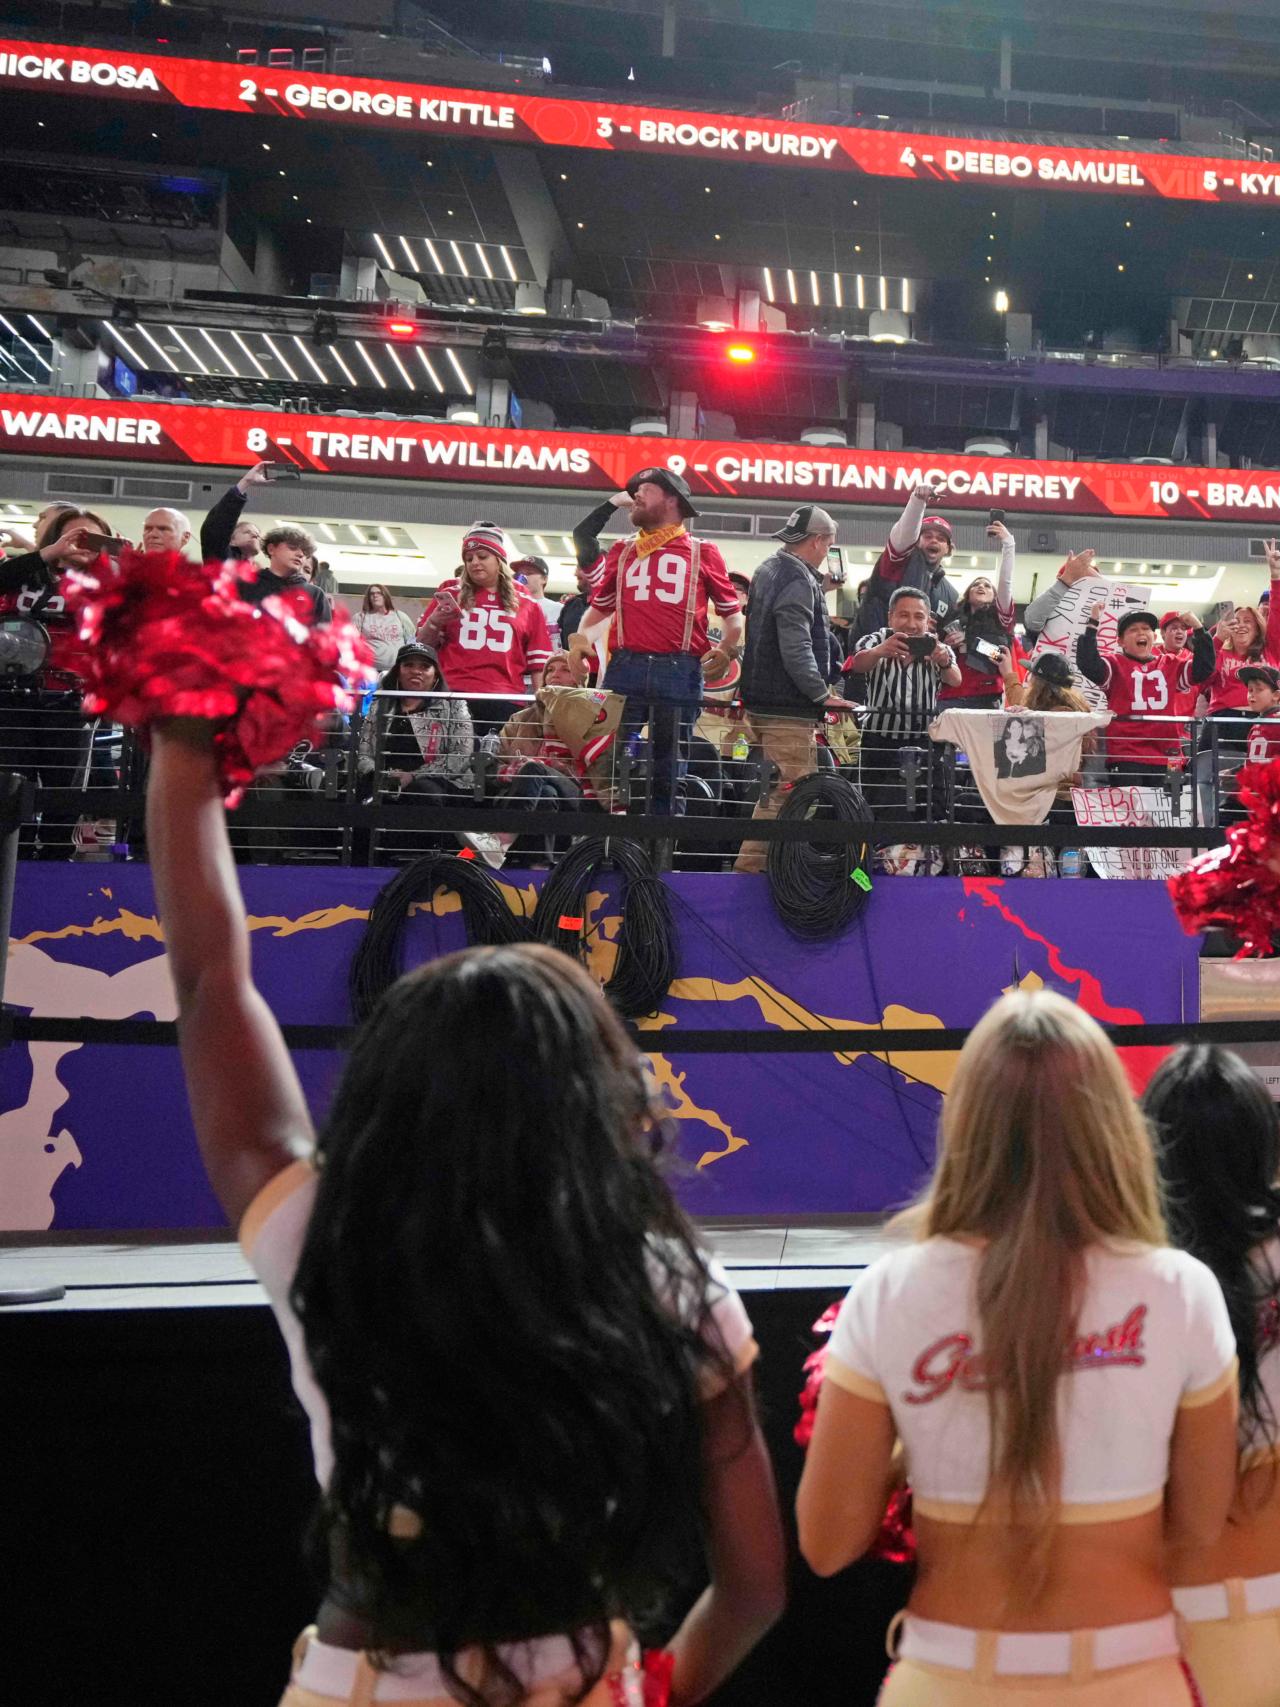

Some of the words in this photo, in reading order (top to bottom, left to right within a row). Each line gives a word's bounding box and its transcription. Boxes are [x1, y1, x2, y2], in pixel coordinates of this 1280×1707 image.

[70, 60, 159, 91] BOSA
[238, 79, 257, 102] 2
[284, 83, 413, 118] GEORGE
[419, 98, 515, 129] KITTLE
[596, 116, 613, 138] 3
[639, 119, 740, 150] BROCK
[744, 129, 838, 160] PURDY
[899, 146, 917, 168] 4
[945, 149, 1033, 178] DEEBO
[1037, 157, 1145, 186] SAMUEL
[1202, 170, 1218, 191] 5
[1, 409, 161, 445] WARNER
[246, 427, 268, 452] 8
[306, 430, 418, 462] TRENT
[421, 438, 591, 473] WILLIAMS
[666, 454, 687, 479] 9
[715, 456, 887, 491] CHRISTIAN
[893, 466, 1081, 500] MCCAFFREY
[1149, 480, 1180, 504] 10
[625, 553, 687, 604] 49
[458, 607, 514, 653] 85
[1131, 669, 1169, 711] 13
[1071, 786, 1145, 825] DEEBO
[1160, 849, 1180, 869] ONE
[1265, 1077, 1280, 1085] LEFT
